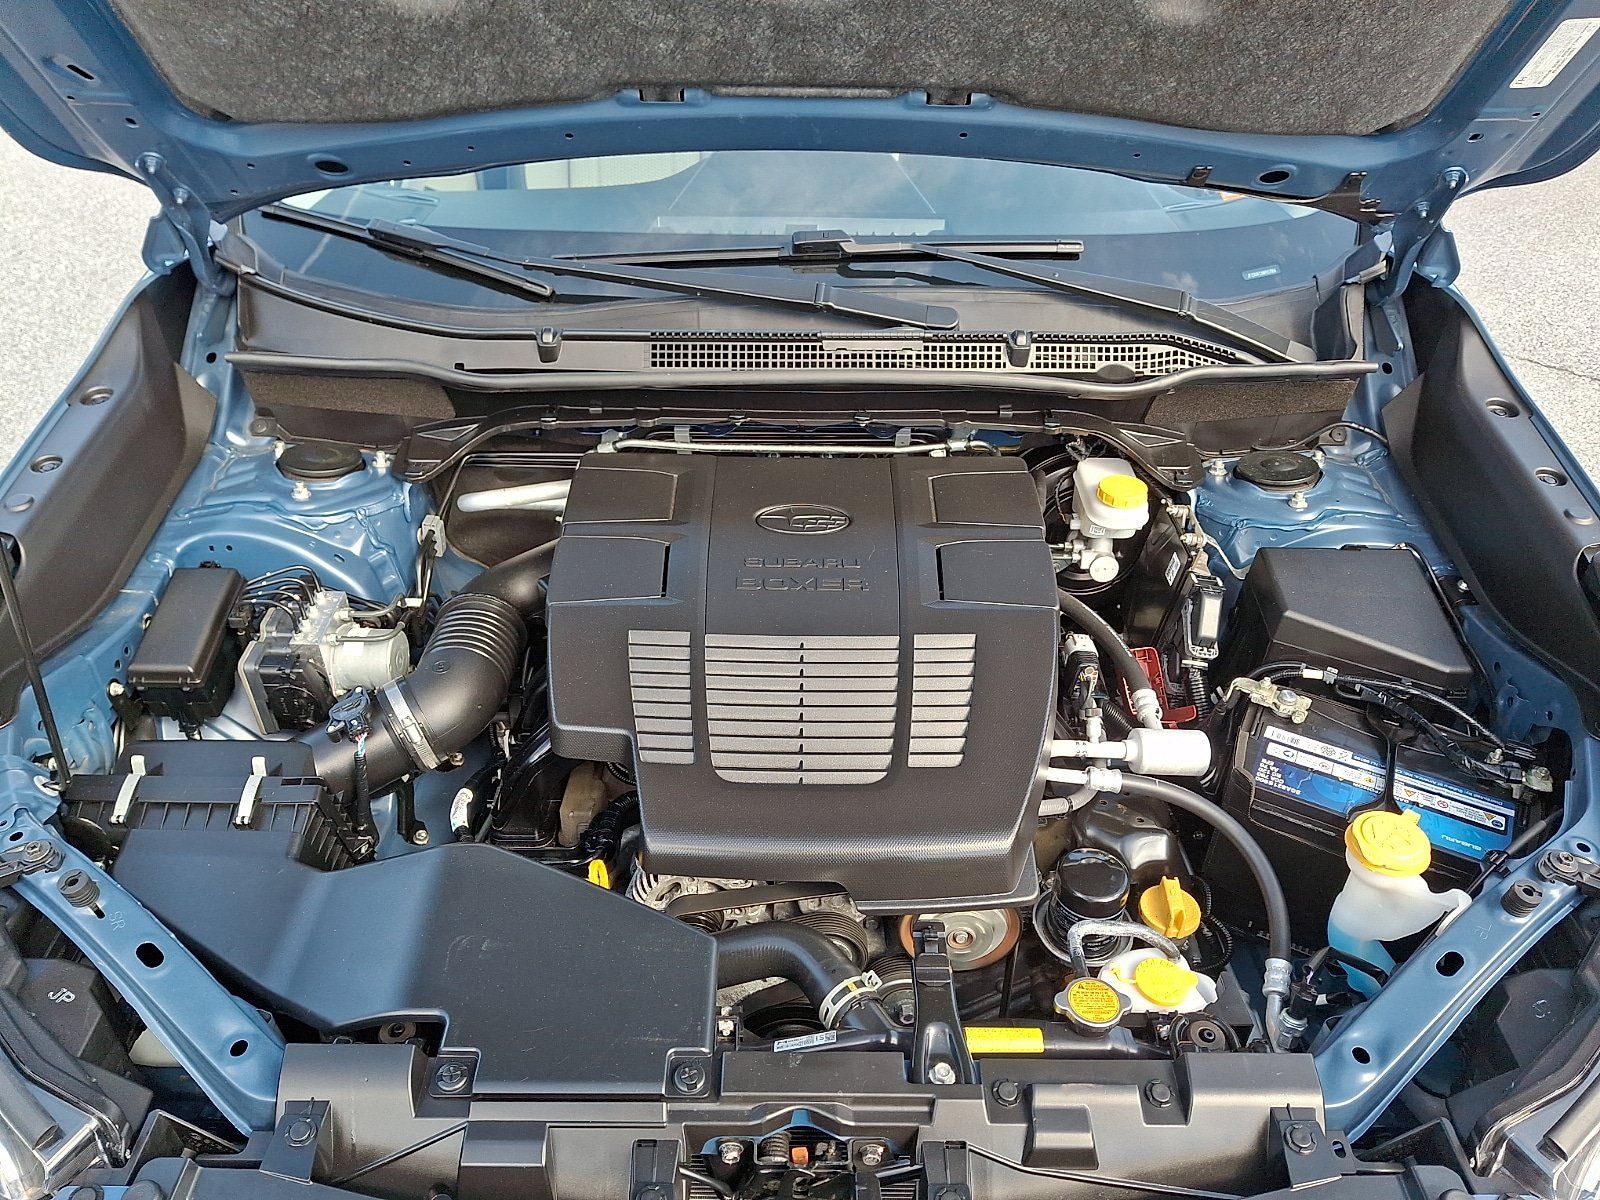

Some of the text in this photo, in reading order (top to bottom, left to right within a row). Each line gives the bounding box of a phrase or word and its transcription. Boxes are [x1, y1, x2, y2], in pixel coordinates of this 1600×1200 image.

[744, 557, 861, 569] SUBARU
[736, 577, 870, 592] BOXER
[1441, 834, 1482, 851] SUBARU
[47, 987, 76, 1004] JP
